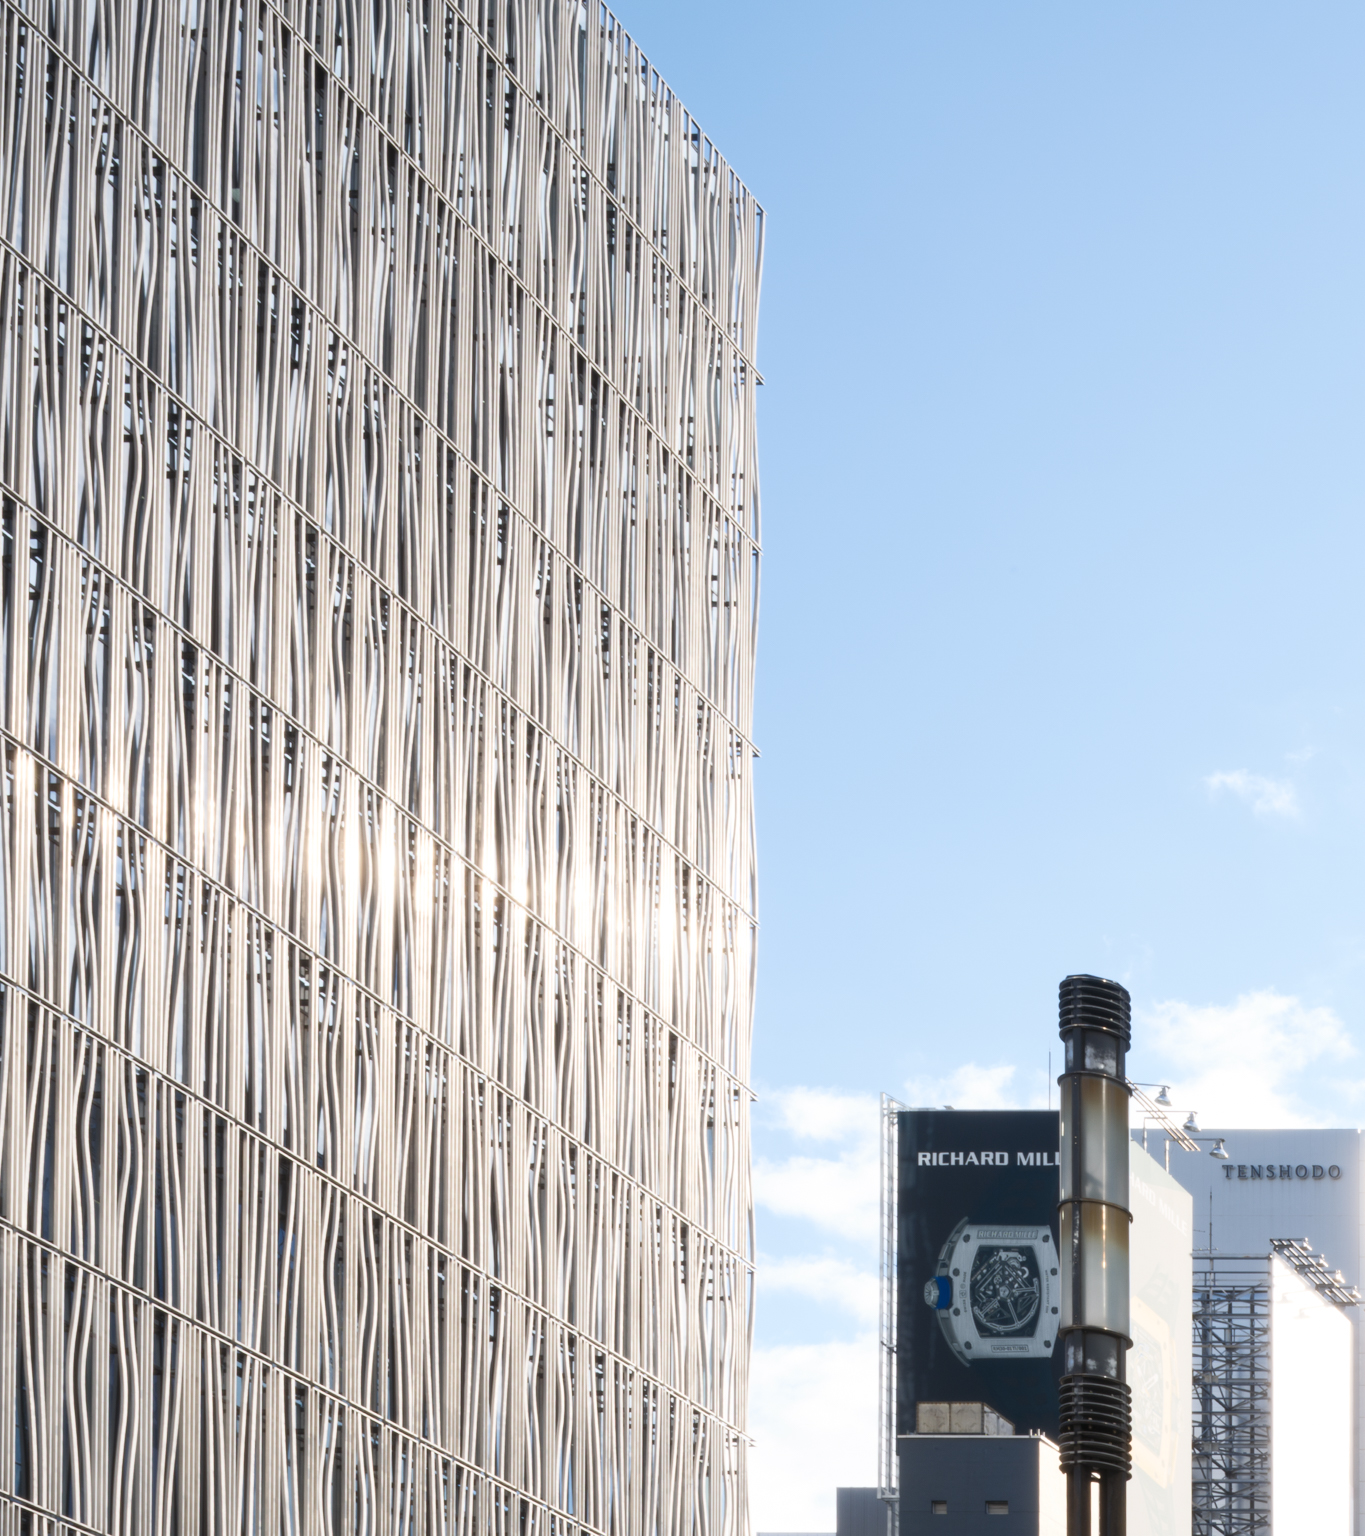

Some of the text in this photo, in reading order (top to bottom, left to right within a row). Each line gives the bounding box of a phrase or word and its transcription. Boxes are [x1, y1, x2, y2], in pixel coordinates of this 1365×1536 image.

[918, 1151, 1059, 1166] RICHARD MILL
[1221, 1163, 1343, 1180] TENSHODO
